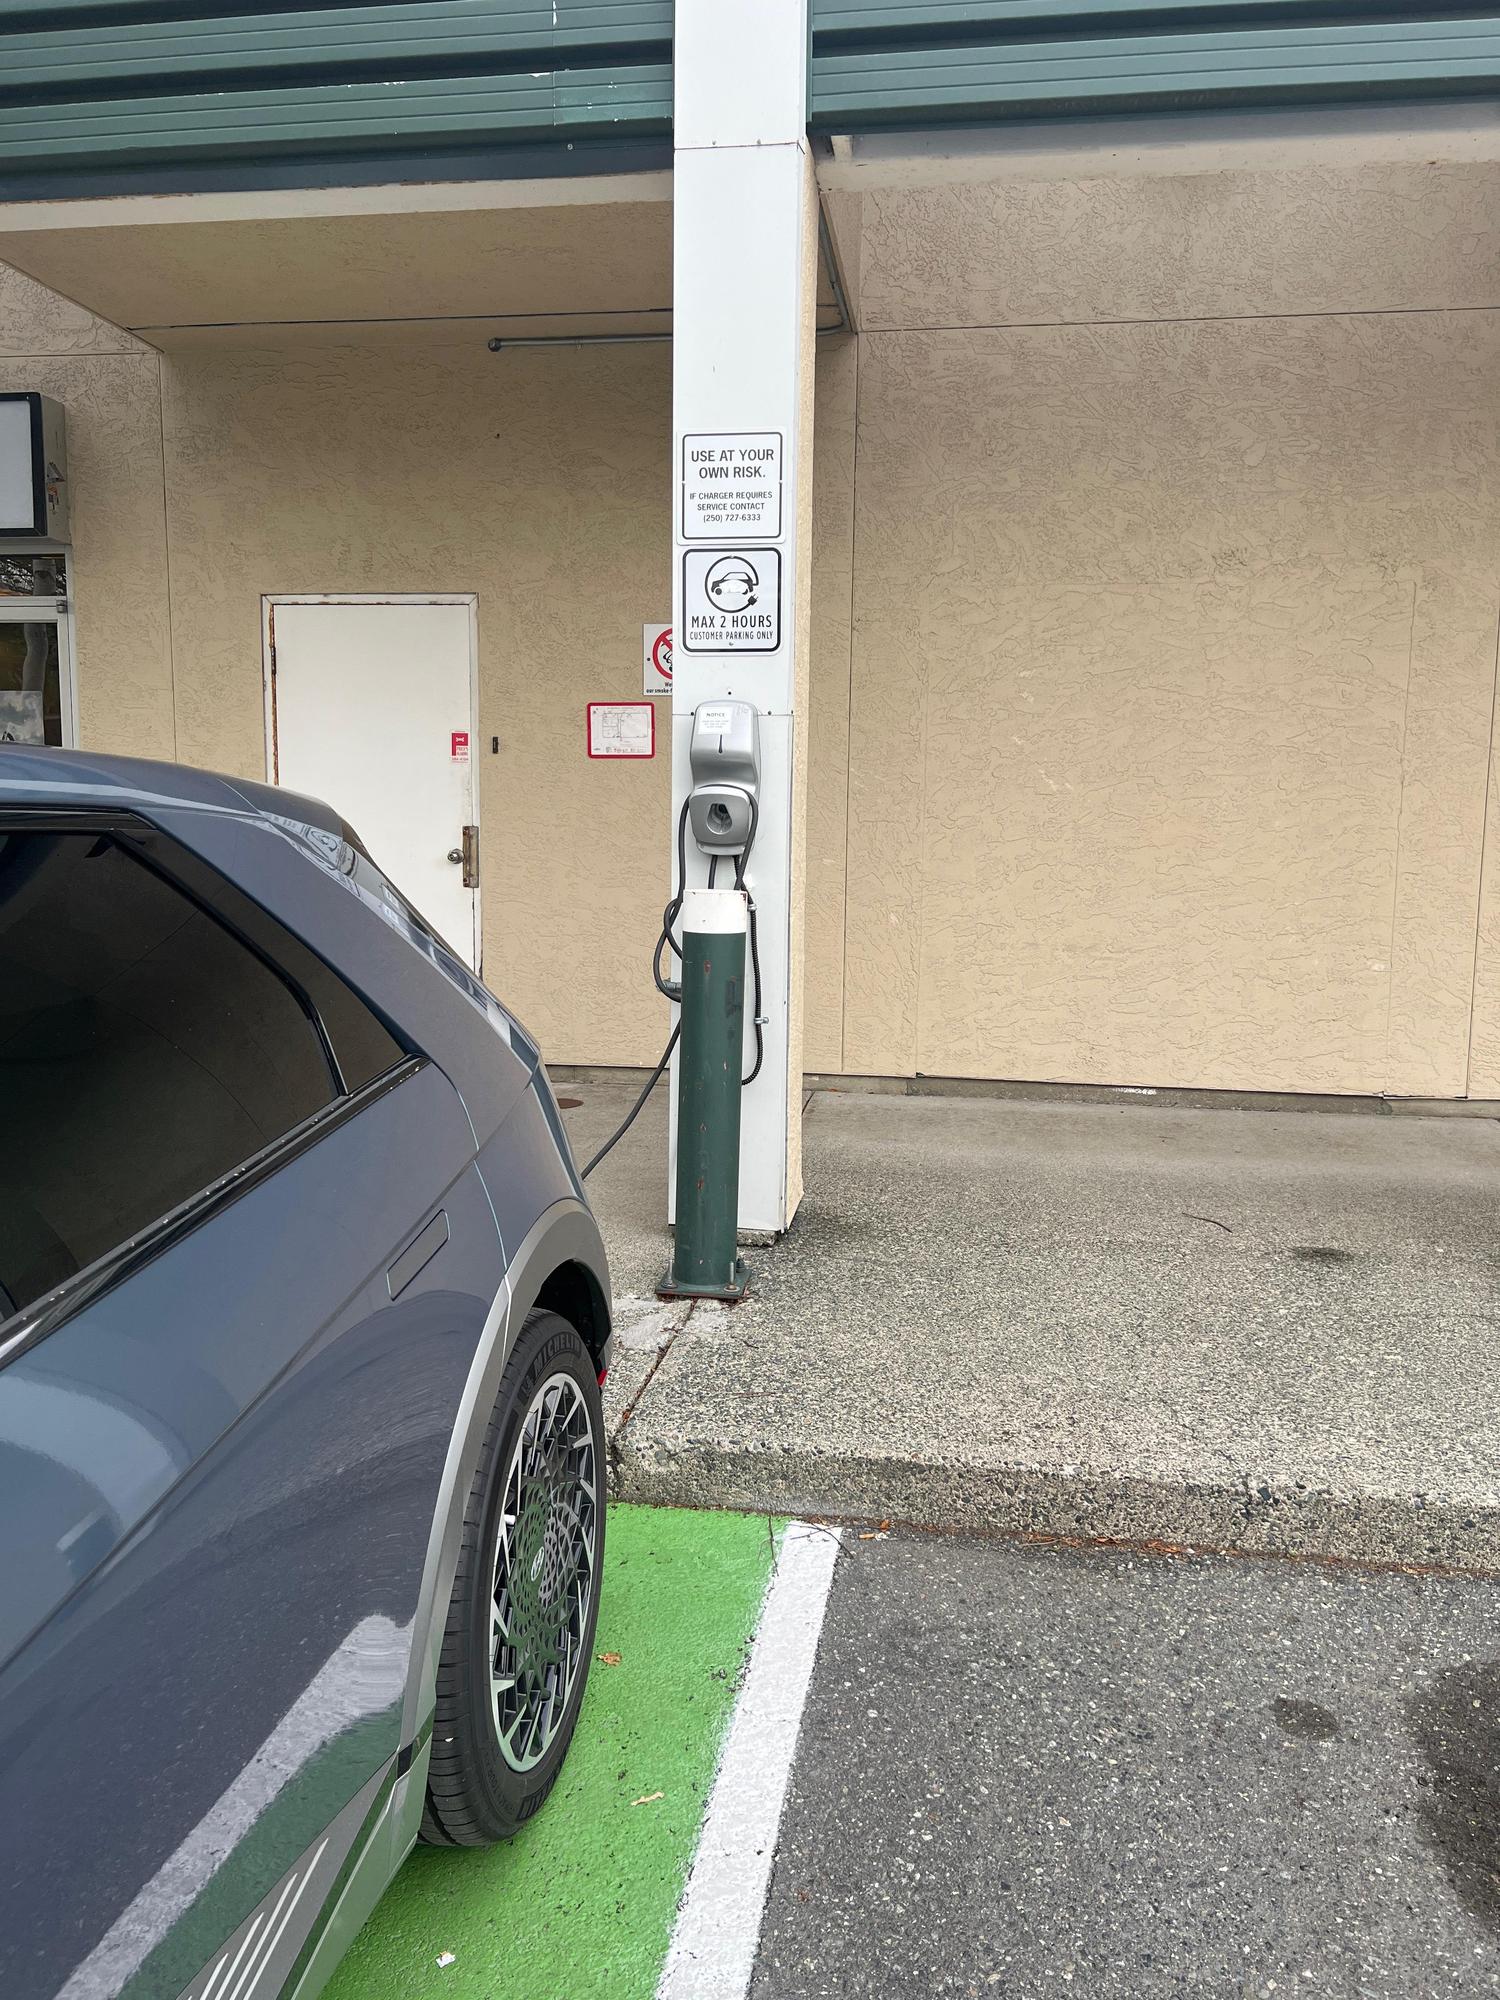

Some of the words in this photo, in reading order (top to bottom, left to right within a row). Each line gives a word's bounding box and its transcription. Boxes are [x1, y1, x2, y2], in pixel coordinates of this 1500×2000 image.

[691, 450, 716, 462] USE
[719, 449, 735, 461] AT
[739, 448, 775, 461] YOUR
[698, 467, 729, 479] OWN
[733, 465, 766, 478] RISK.
[698, 492, 734, 500] CHARGER
[736, 491, 773, 500] REQUIRES
[697, 503, 728, 511] SERVICE
[730, 502, 765, 510] CONTACT
[703, 514, 723, 523] (250)
[725, 513, 761, 522] 727-6333
[691, 616, 715, 628] MAX
[720, 616, 727, 628] 2
[732, 615, 772, 628] HOURS
[689, 631, 723, 640] CUSTOMER
[725, 631, 754, 640] PARKING
[756, 630, 774, 640] ONLY
[532, 1333, 582, 1378] MICHELIN
